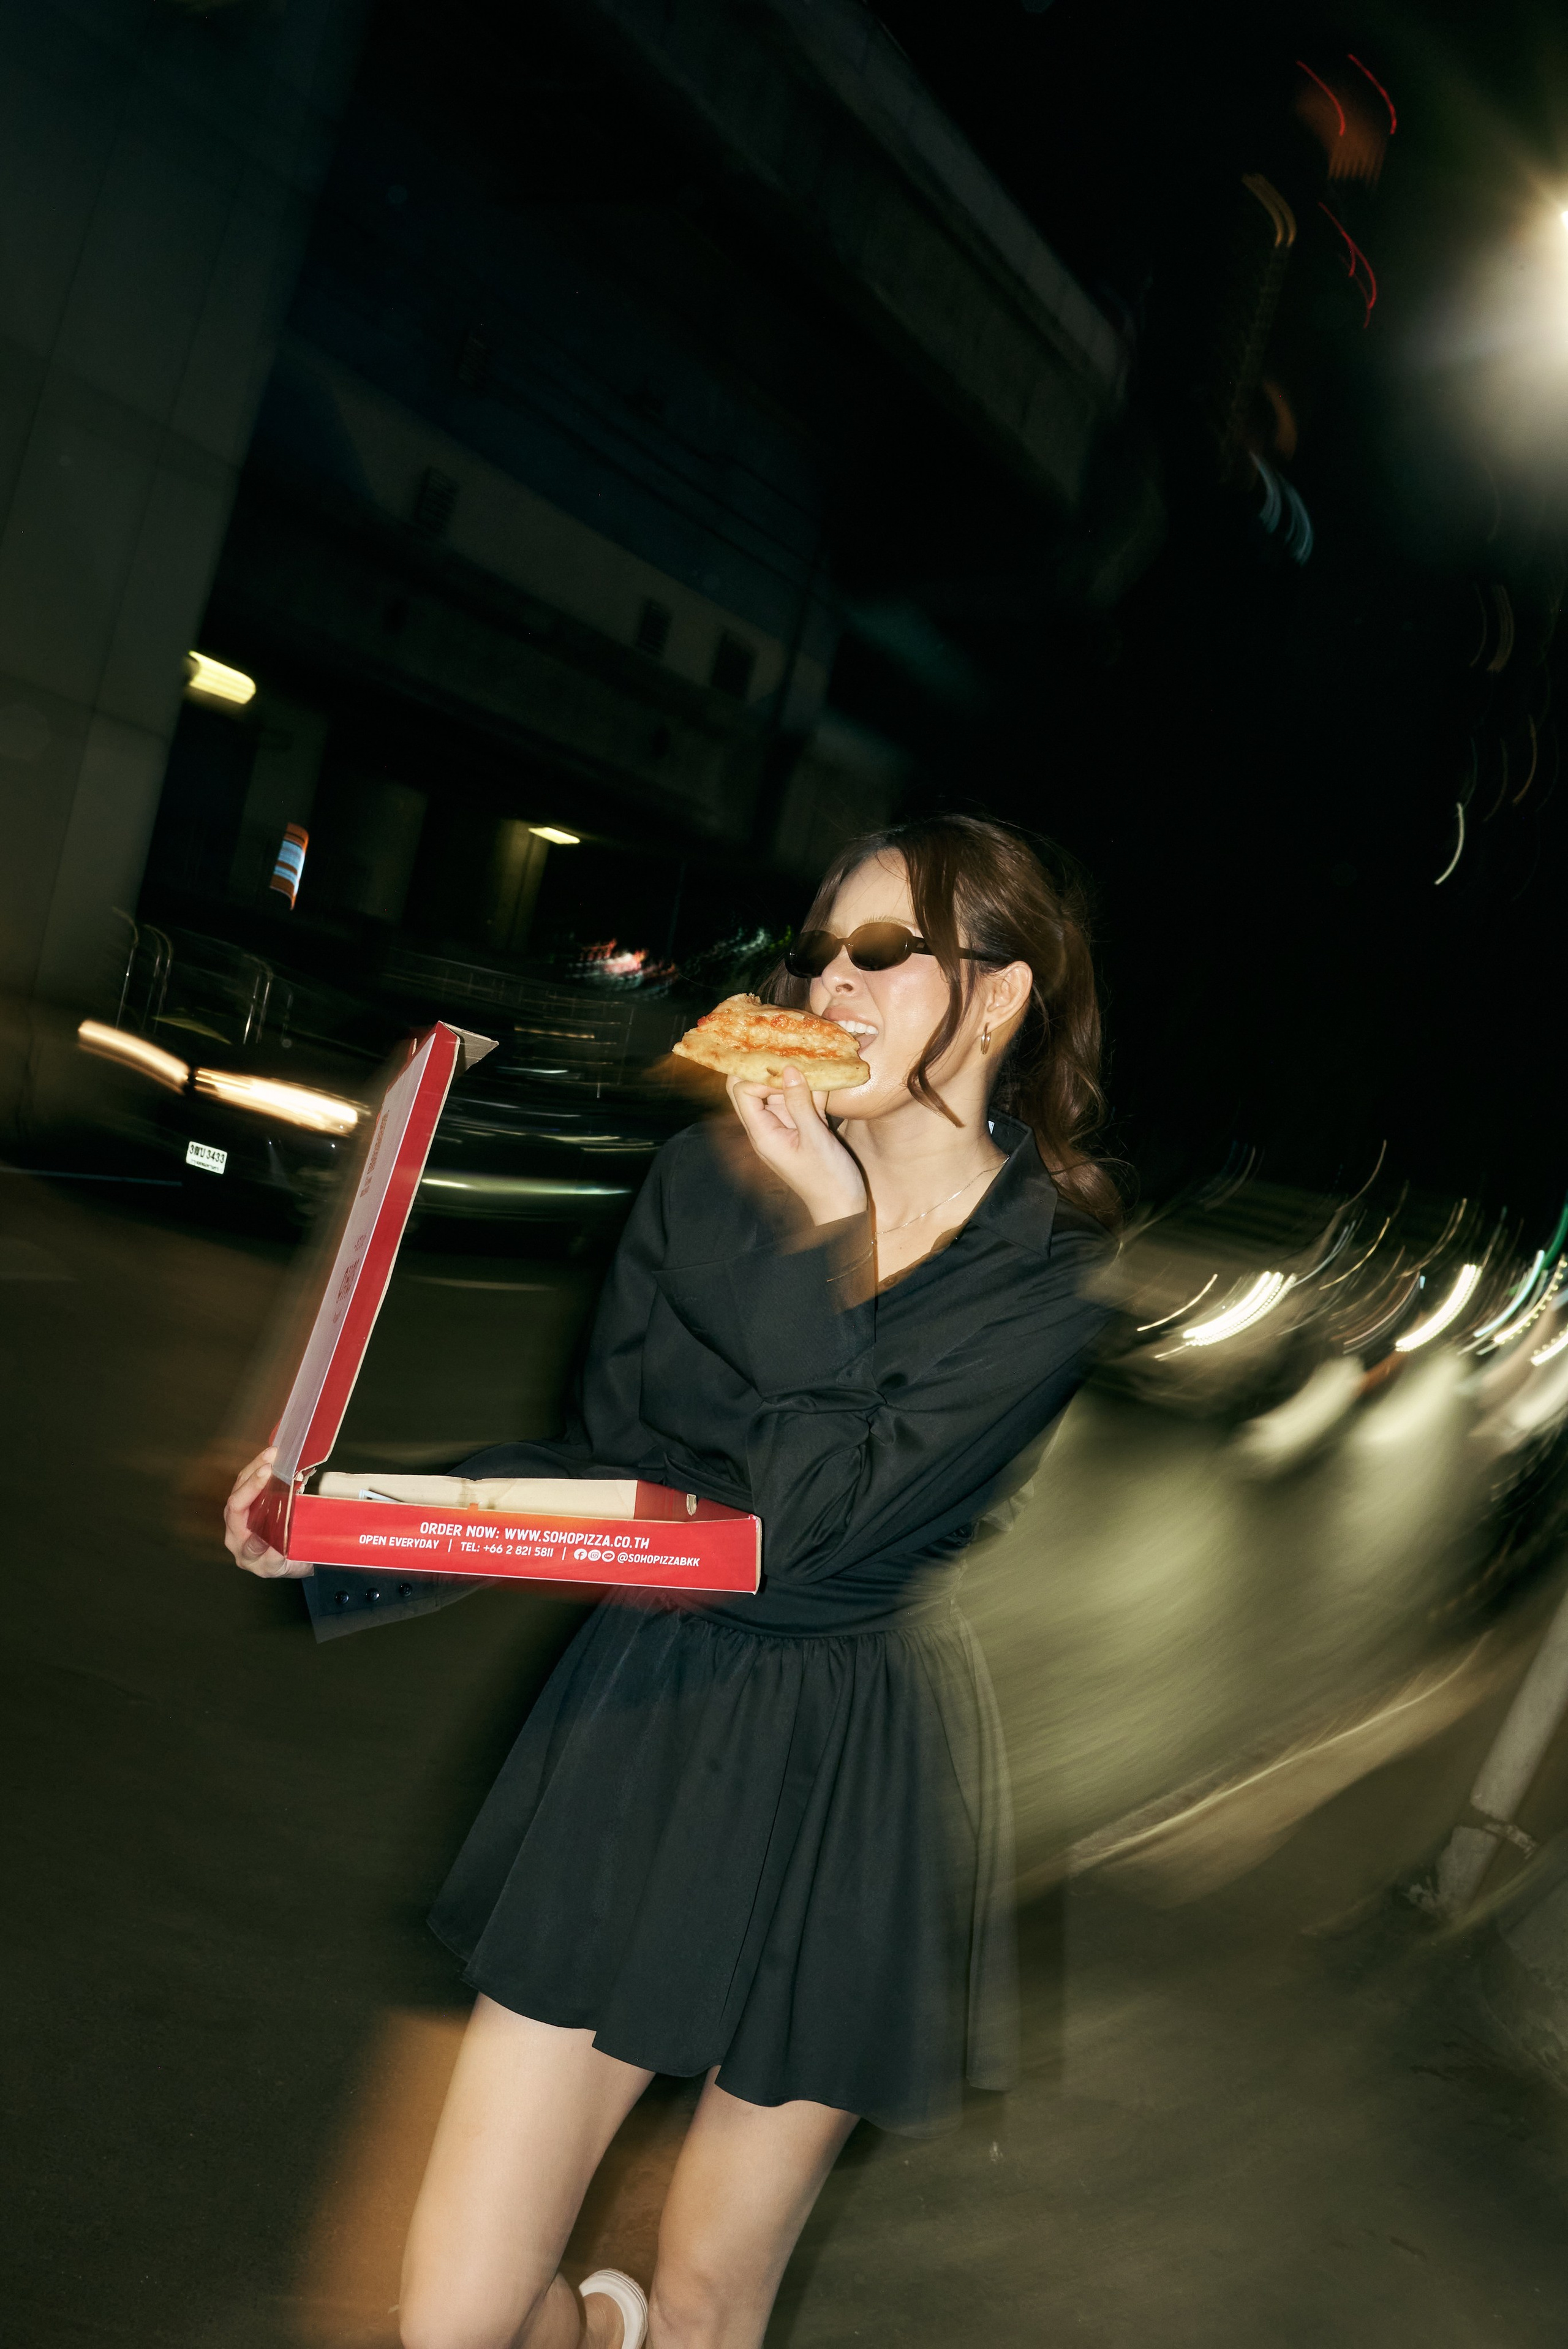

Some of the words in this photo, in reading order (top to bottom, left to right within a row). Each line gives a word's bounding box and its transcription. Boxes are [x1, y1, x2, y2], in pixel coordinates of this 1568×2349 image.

[206, 1150, 225, 1163] 3433
[359, 1534, 387, 1546] OPEN
[388, 1536, 440, 1549] EVERYDAY
[420, 1522, 462, 1537] ORDER
[466, 1525, 500, 1539] NOW:
[505, 1528, 650, 1549] WWW.SOHOPIZZA.CO.TH
[461, 1541, 480, 1552] TEL:
[483, 1544, 503, 1554] +66
[505, 1545, 513, 1554] 2
[515, 1545, 532, 1556] 821
[534, 1547, 554, 1557] 5811
[617, 1552, 700, 1567] @SOHOPIZZABKK
